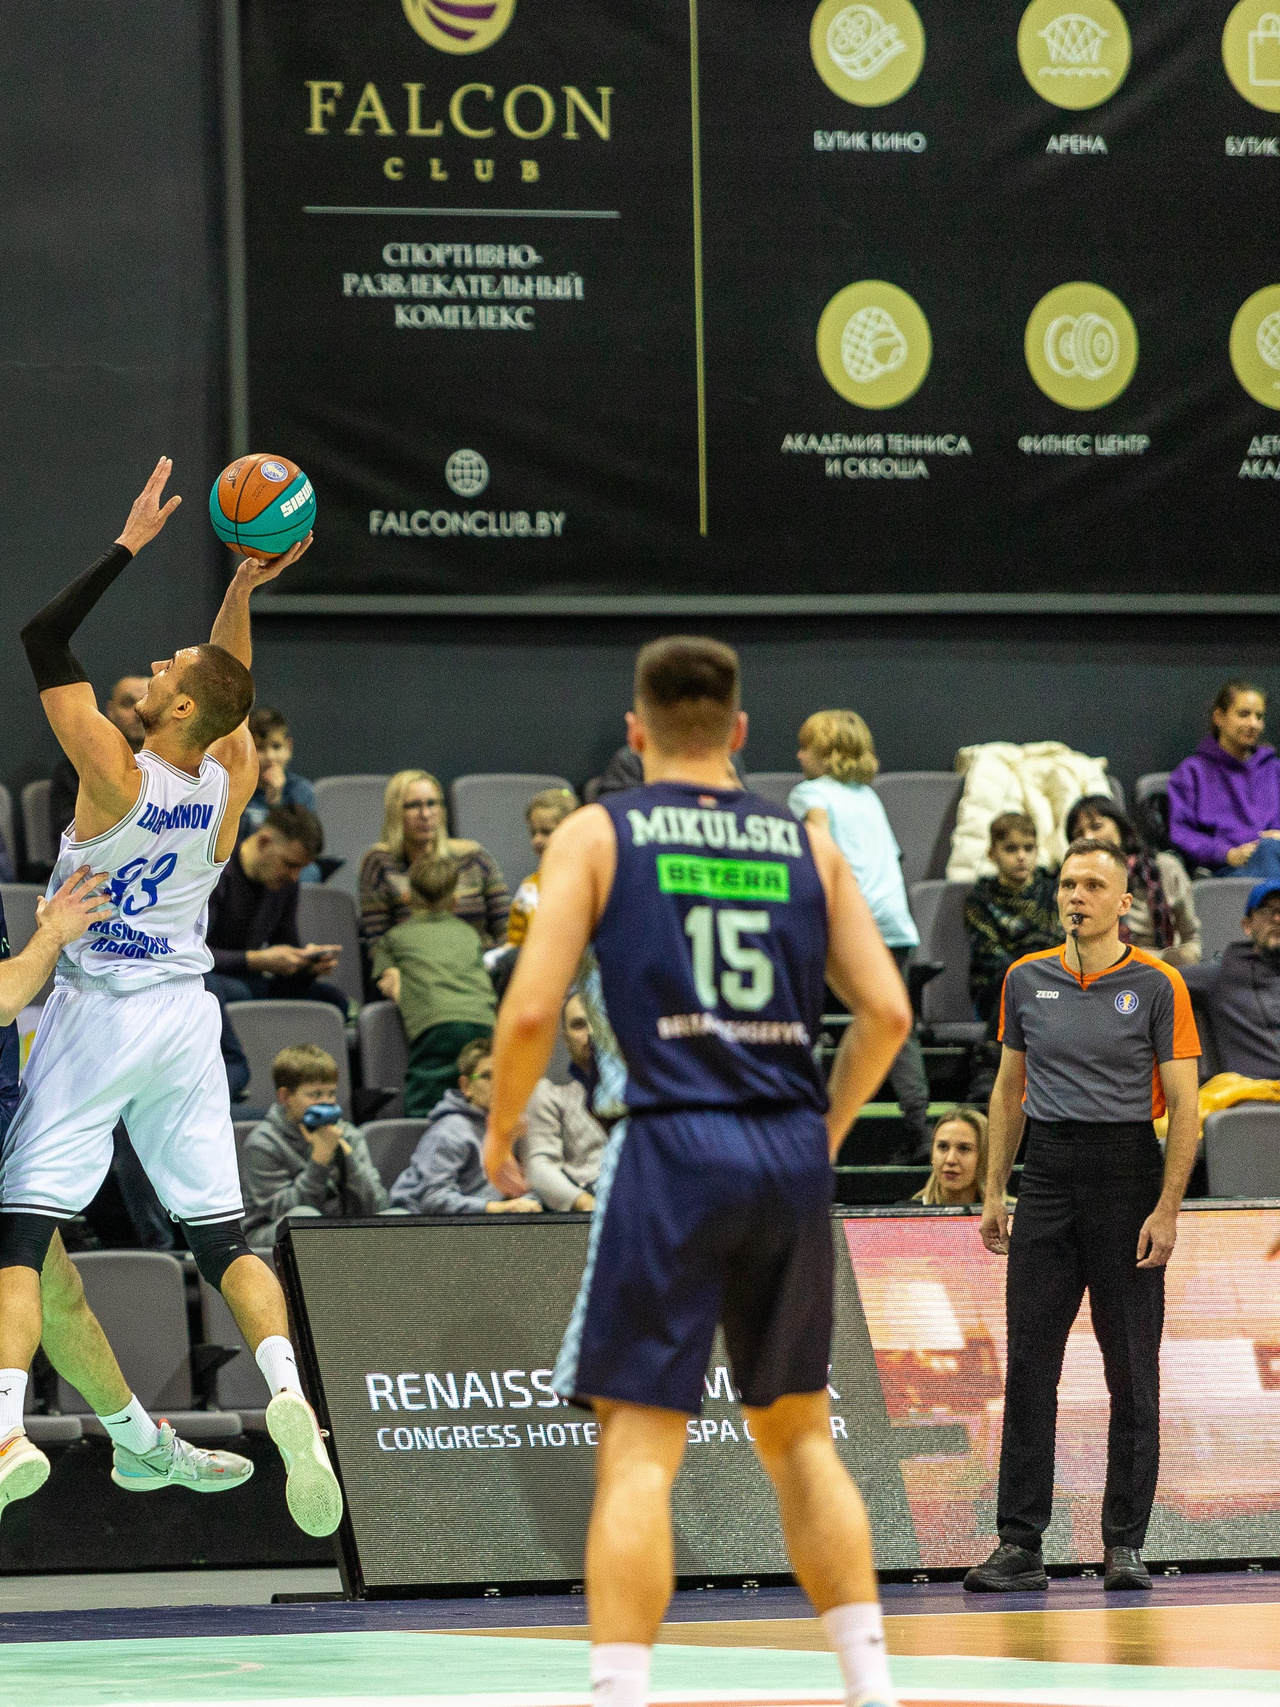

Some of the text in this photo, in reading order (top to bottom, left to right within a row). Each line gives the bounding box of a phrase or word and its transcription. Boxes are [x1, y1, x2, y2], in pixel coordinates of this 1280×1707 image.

[304, 80, 614, 141] FALCON
[813, 130, 927, 153] БУТИК КИНО
[1046, 134, 1108, 154] АРЕНА
[383, 156, 541, 183] CLUB
[382, 242, 544, 269] СПОРТИВНО-
[342, 271, 585, 300] РАЗВЛЕКАТЕЛЬНЫЙ
[394, 303, 536, 330] КОМПЛЕКС
[780, 433, 973, 456] АКАДЕМИЯ ТЕННИСА
[1017, 434, 1093, 456] ФИТНЕС
[1246, 435, 1280, 457] ДЕТ
[825, 457, 930, 479] И СКВОША
[369, 509, 566, 537] FALCONCLUB.BY
[626, 805, 803, 859] MIKULSKI
[684, 904, 774, 1012] 15
[1035, 990, 1060, 1000] ZEDO
[365, 1369, 569, 1411] RENAISS
[376, 1424, 522, 1451] CONGRESS
[686, 1418, 739, 1444] SPA
